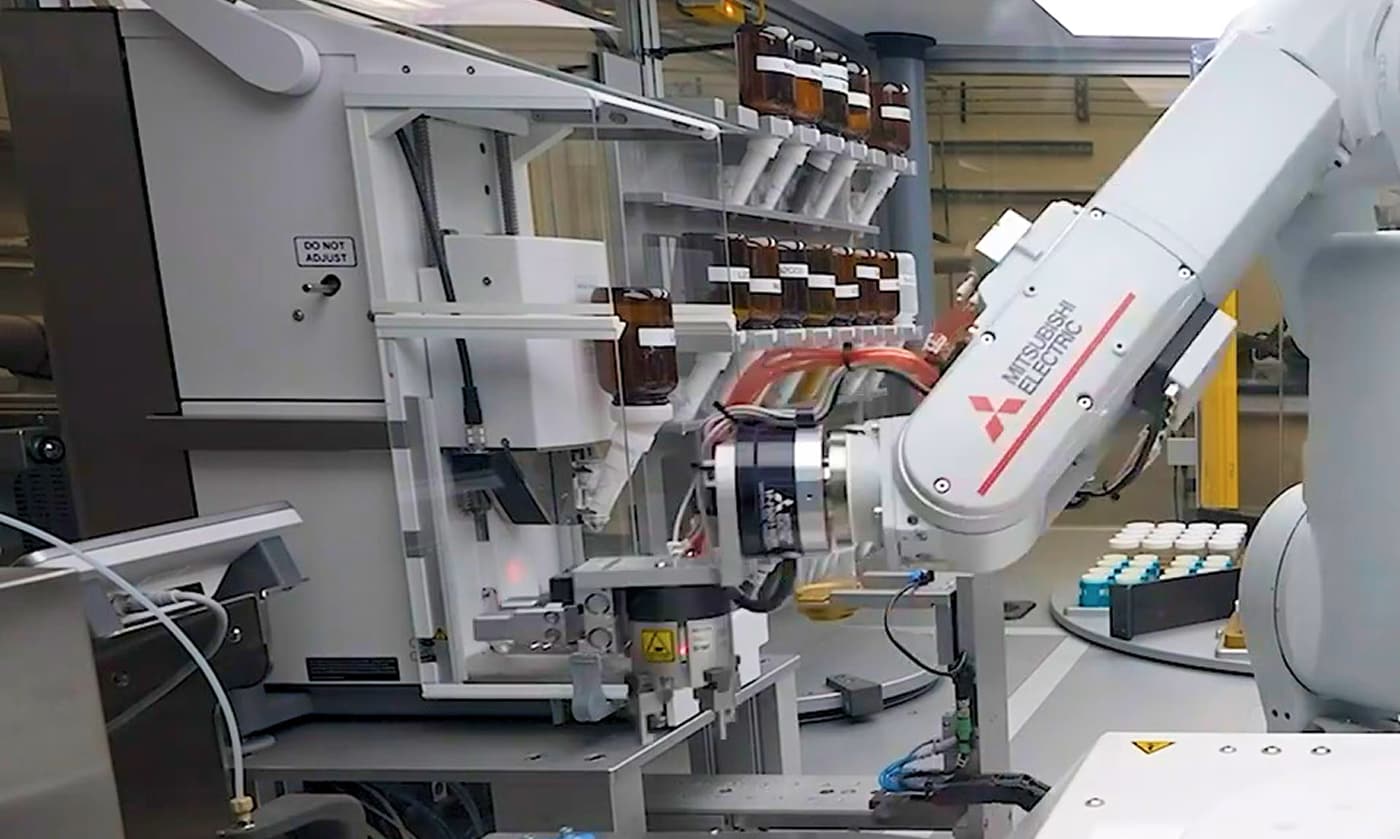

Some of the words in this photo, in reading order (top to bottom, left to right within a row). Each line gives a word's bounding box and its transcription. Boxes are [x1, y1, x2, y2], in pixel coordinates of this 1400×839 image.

[304, 241, 320, 250] DO
[322, 241, 344, 250] NOT
[306, 253, 346, 263] ADJUST
[1001, 299, 1076, 385] MITSUBISHI
[1018, 320, 1082, 395] ELECTRIC
